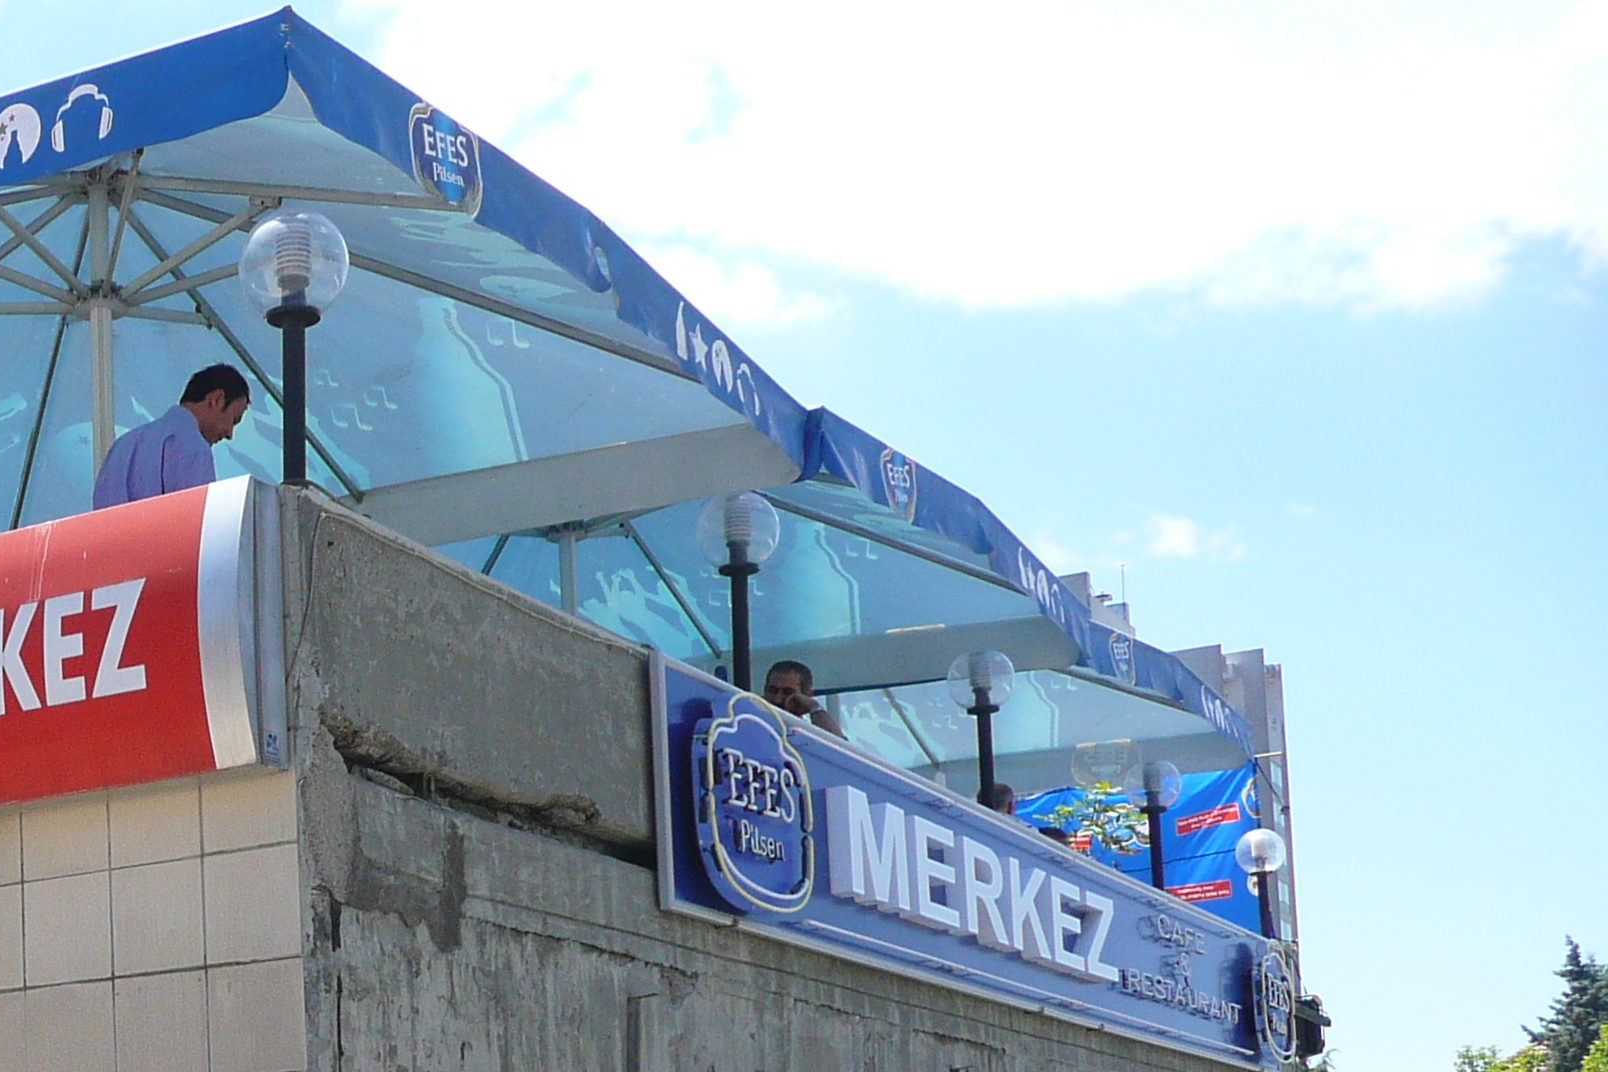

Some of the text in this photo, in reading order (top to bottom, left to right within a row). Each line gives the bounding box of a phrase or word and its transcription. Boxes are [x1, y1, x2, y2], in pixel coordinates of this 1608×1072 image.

[422, 123, 468, 167] EFES
[433, 162, 465, 188] Pilsen
[722, 748, 795, 823] EFES
[741, 819, 787, 861] Pilsen
[828, 785, 1120, 983] MERKEZ
[1157, 914, 1205, 955] CAFE
[1180, 953, 1190, 977] &
[1127, 969, 1241, 1023] RESTAURANT
